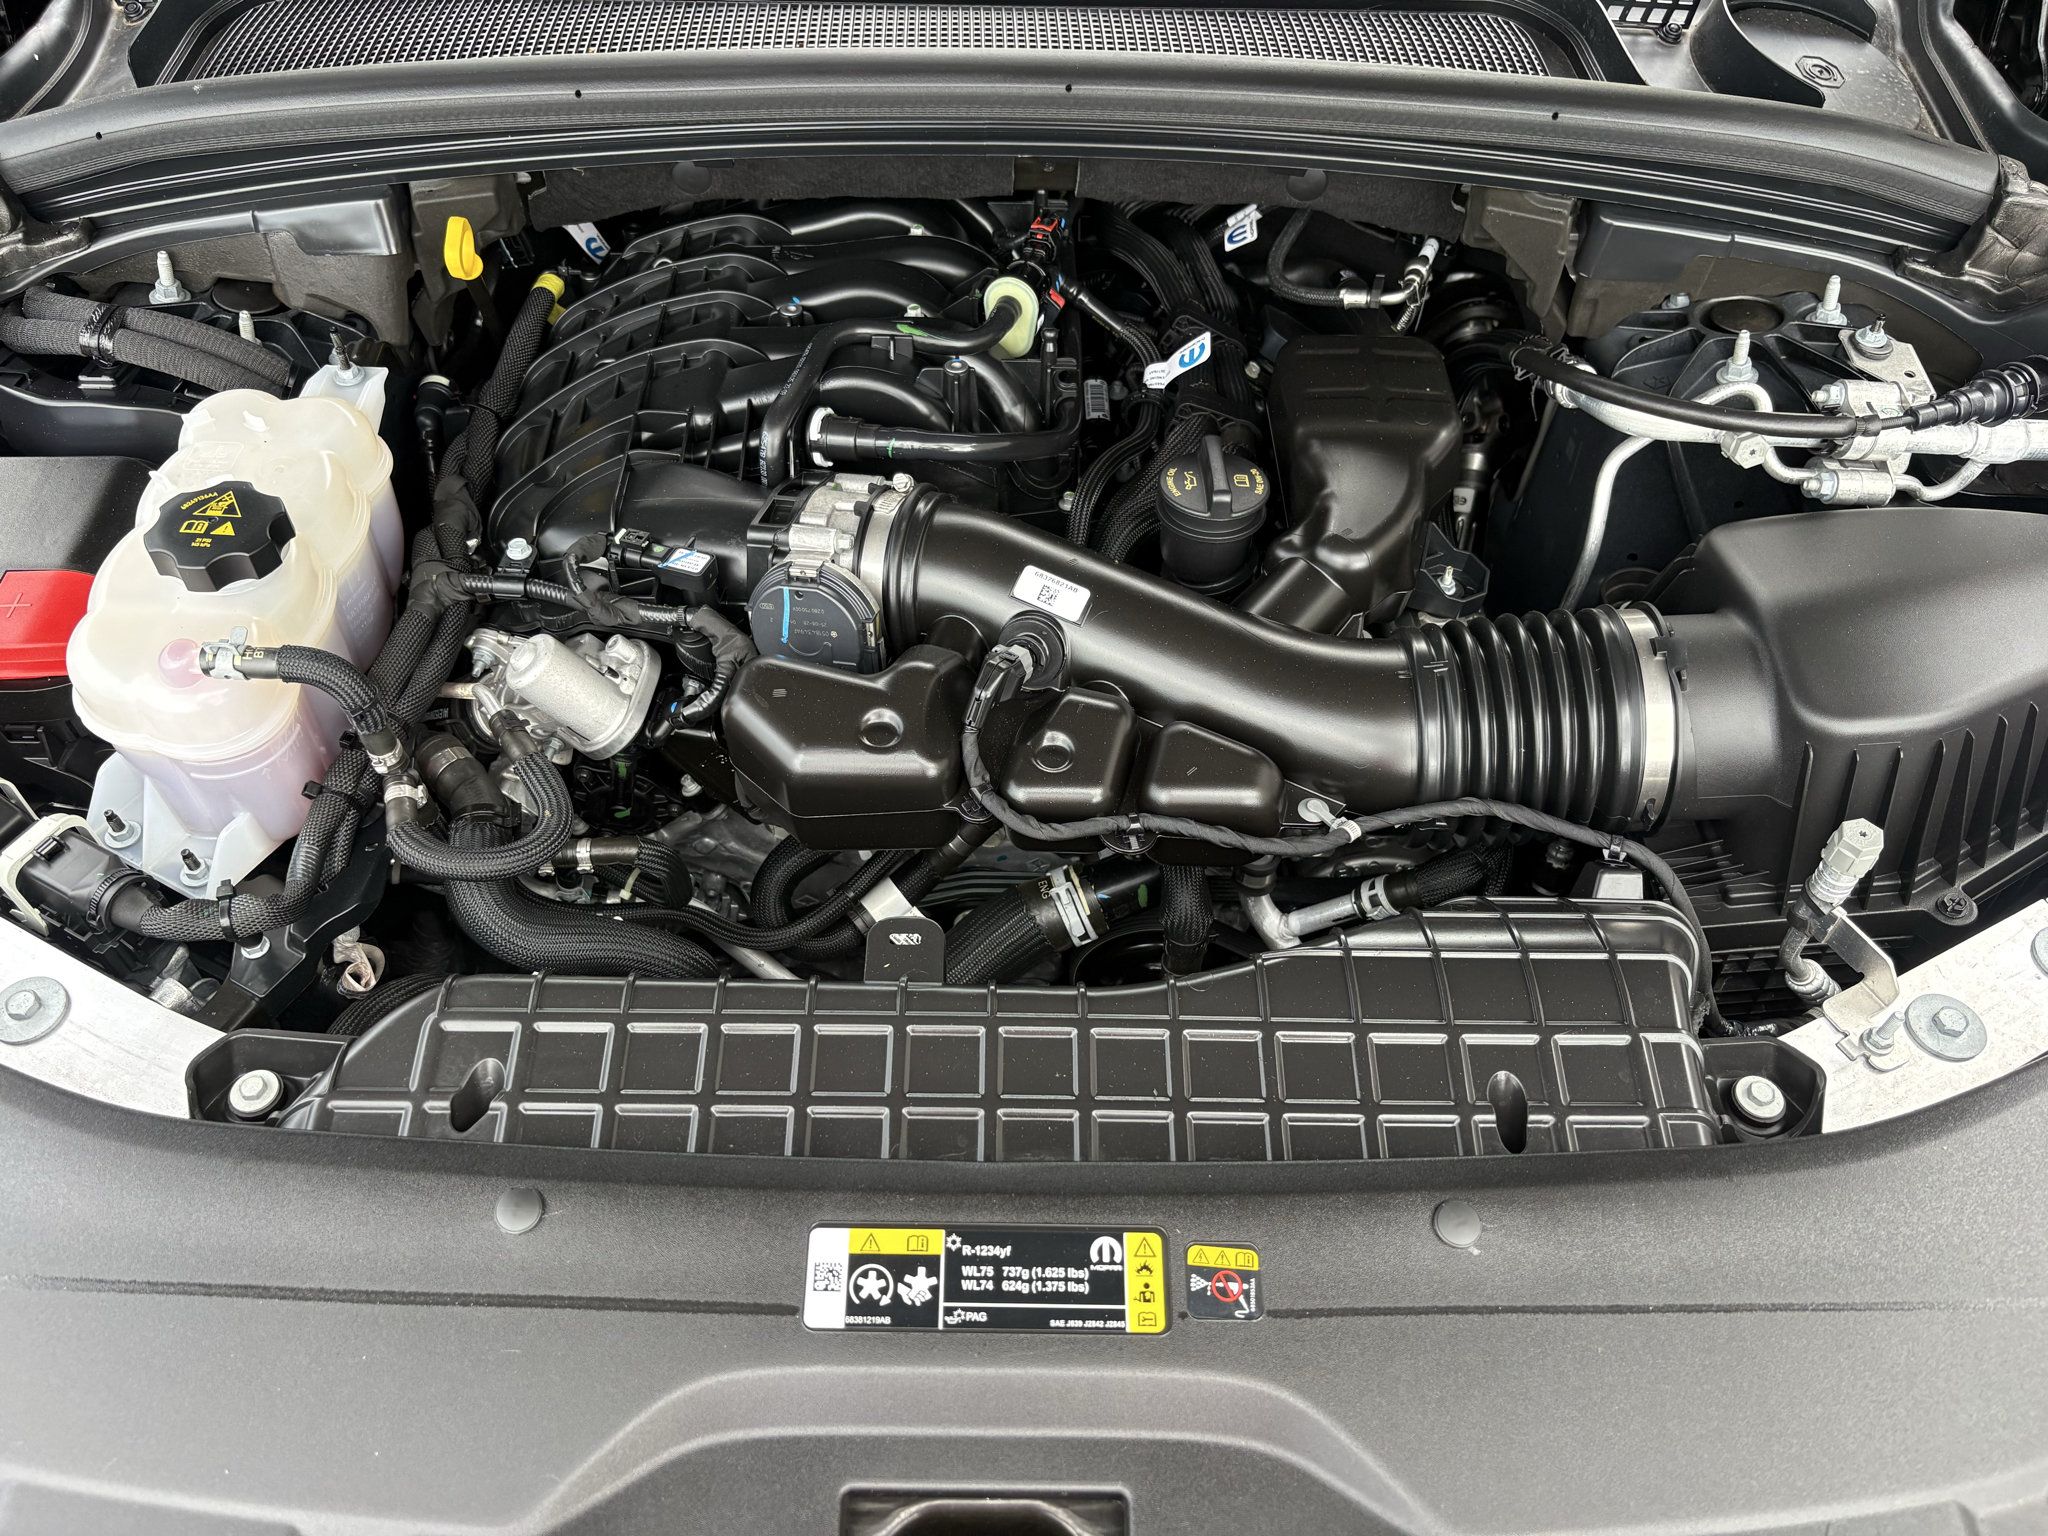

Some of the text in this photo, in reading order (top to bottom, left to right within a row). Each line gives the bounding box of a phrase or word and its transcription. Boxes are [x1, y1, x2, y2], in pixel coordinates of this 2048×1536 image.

[1166, 467, 1182, 496] ENGINE OIL
[1038, 880, 1051, 900] ENG
[962, 1245, 1012, 1259] R-1234yf
[961, 1265, 1089, 1280] WL75 737g (1.625 lbs)
[961, 1279, 1089, 1294] WL74 624g (1.375 lbs)
[965, 1311, 988, 1322] PAG
[1049, 1319, 1065, 1327] SAE
